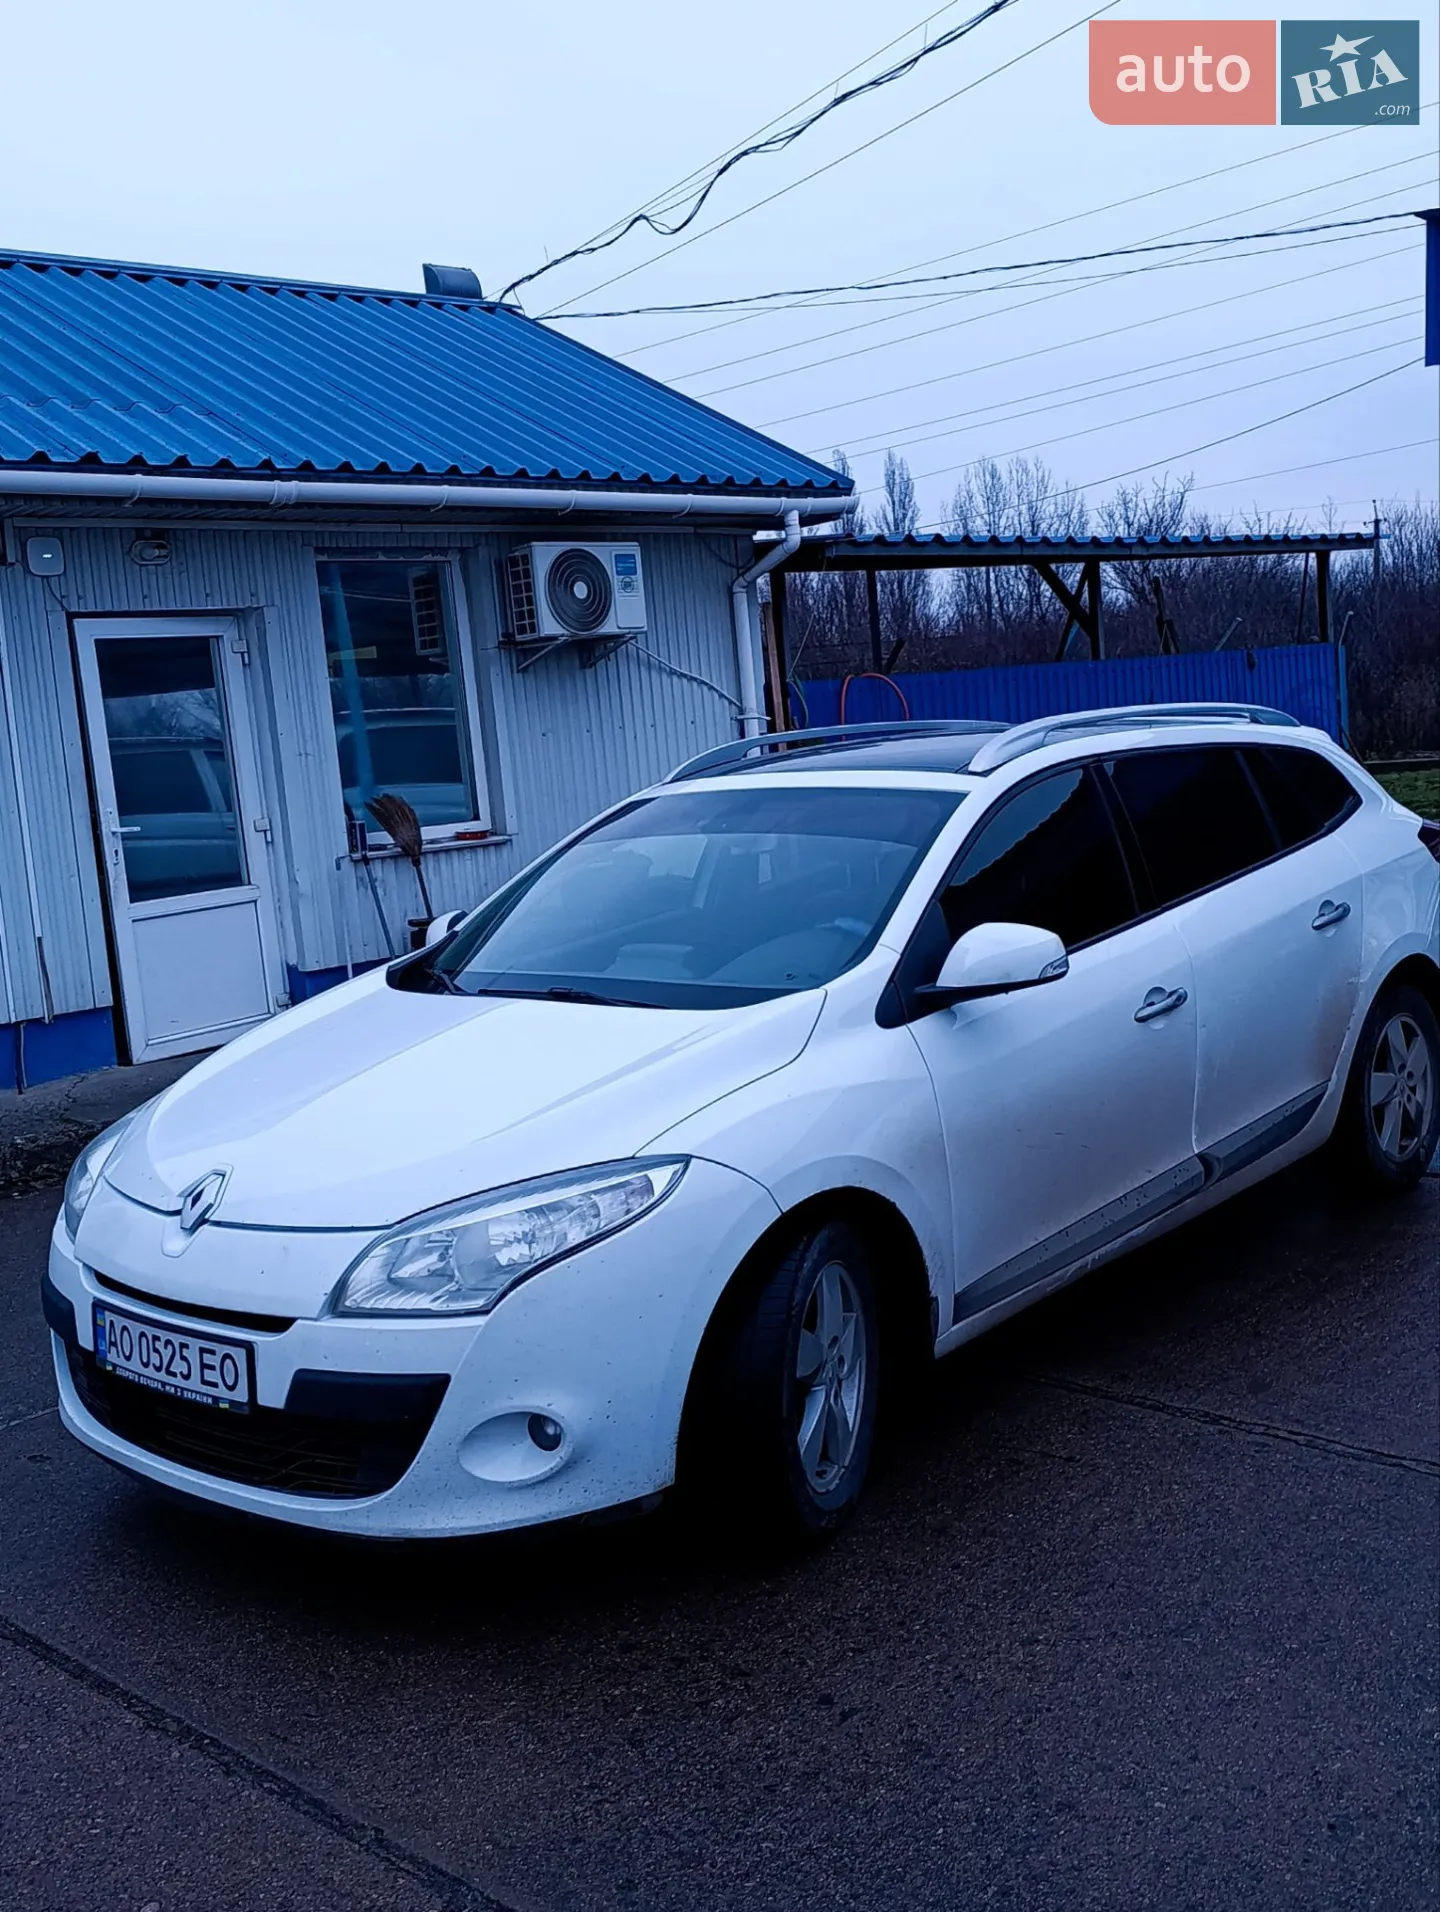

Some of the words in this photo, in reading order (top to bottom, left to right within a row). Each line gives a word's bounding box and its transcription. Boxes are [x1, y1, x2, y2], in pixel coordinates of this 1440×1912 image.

[108, 1319, 134, 1363] AO
[138, 1331, 192, 1381] 0525
[199, 1346, 240, 1392] EO
